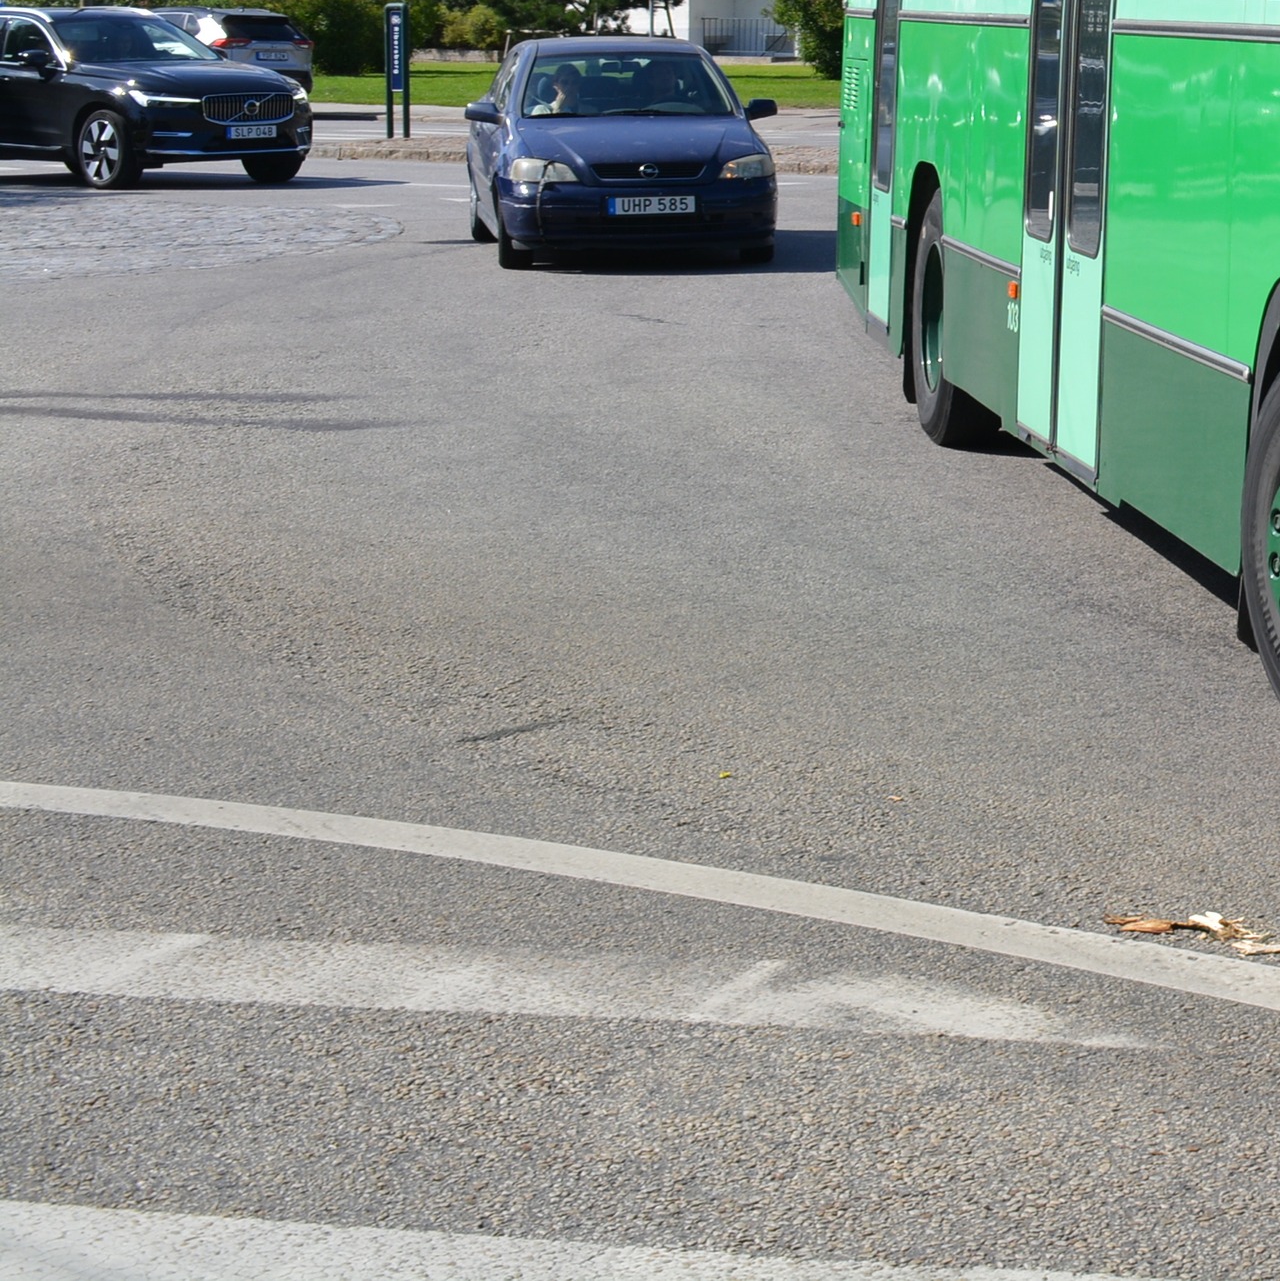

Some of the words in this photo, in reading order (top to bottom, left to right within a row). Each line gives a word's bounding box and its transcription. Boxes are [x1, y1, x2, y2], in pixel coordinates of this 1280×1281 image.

[235, 127, 253, 138] SLP
[621, 198, 652, 213] UHP
[657, 197, 689, 212] 585
[1006, 301, 1020, 333] 103
